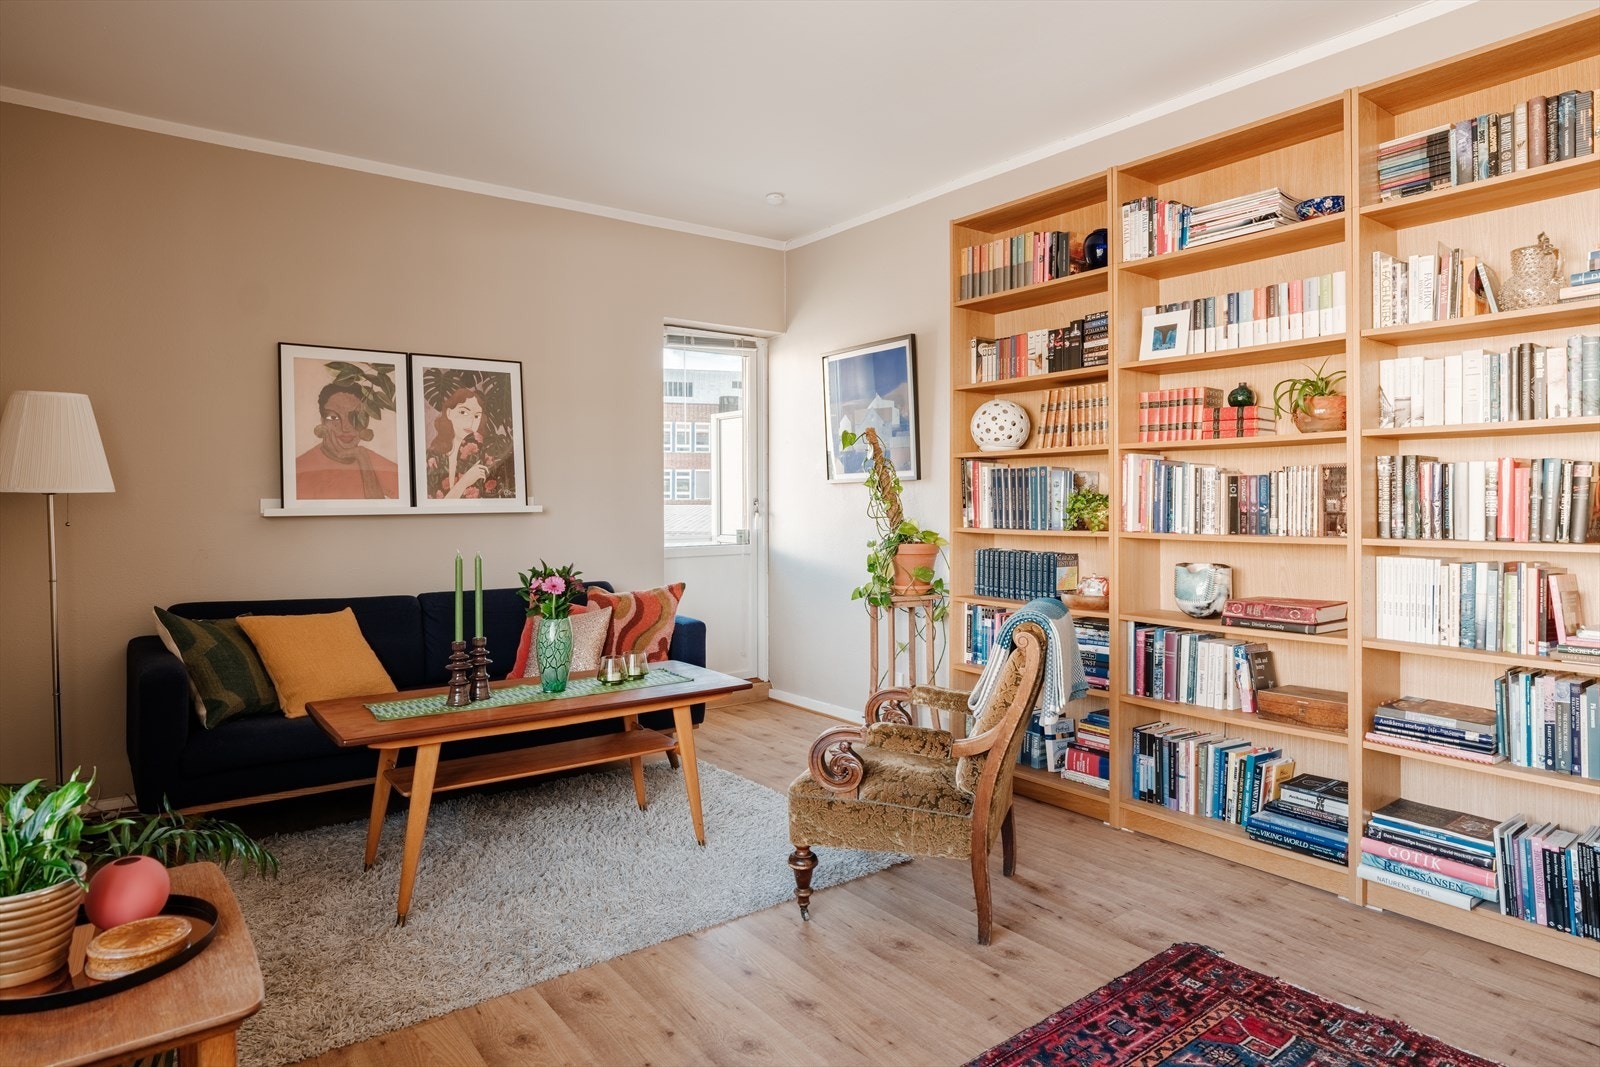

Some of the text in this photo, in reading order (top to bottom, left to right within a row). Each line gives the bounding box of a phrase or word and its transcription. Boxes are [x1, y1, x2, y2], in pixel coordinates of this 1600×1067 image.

[1382, 270, 1391, 322] FACEHUNTER
[1424, 272, 1432, 310] FASHION
[1379, 719, 1404, 728] Antikkens
[1404, 723, 1426, 732] storbyer
[1288, 795, 1316, 805] Archaeology
[1260, 830, 1282, 842] VIKING
[1283, 836, 1308, 849] WORLD
[1388, 846, 1441, 870] GOTIK
[1376, 875, 1432, 897] NATURENS SPEIL
[1383, 859, 1464, 892] RENESSANSEN
